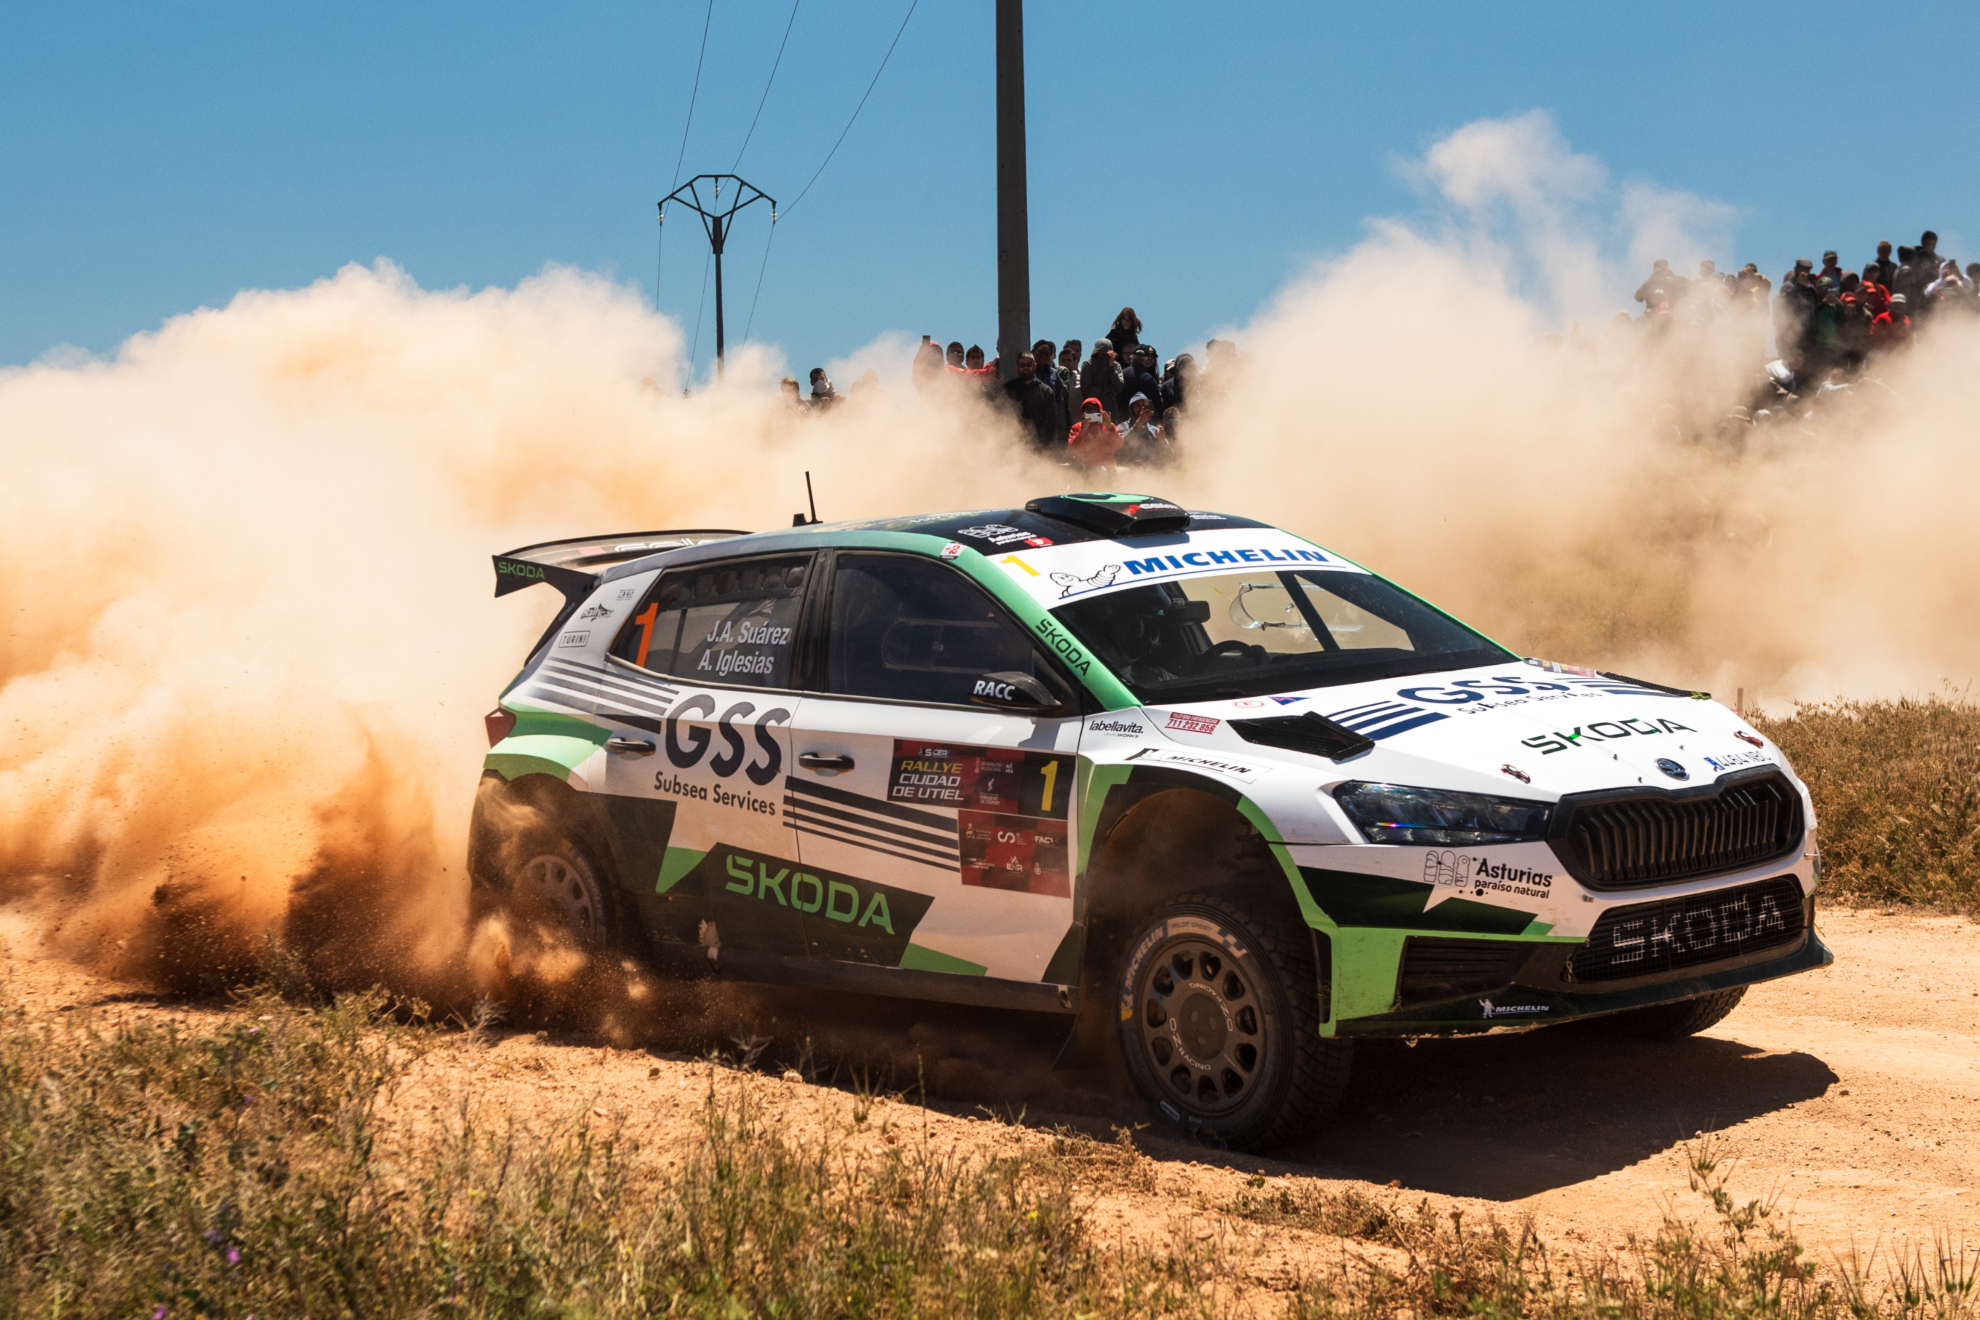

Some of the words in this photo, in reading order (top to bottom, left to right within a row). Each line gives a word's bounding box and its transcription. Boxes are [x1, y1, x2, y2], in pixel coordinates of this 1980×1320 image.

[1000, 554, 1041, 577] 1
[1123, 549, 1330, 575] MICHELIN
[562, 635, 588, 645] TURINI
[635, 602, 659, 668] 1
[707, 620, 734, 642] J.A.
[738, 620, 791, 645] Suárez
[697, 649, 713, 671] A.
[715, 649, 774, 676] Iglesias
[973, 680, 1016, 700] RACC
[1397, 676, 1570, 705] GSS
[1167, 719, 1182, 728] 711
[1183, 721, 1199, 730] 232
[665, 693, 791, 786] GSS
[900, 760, 963, 774] RALLYE
[1166, 755, 1252, 774] MICHELIN
[899, 773, 961, 787] CIUDAD
[1041, 760, 1058, 811] 1
[654, 771, 707, 801] Subsea
[713, 783, 775, 816] Services
[892, 786, 915, 798] DE
[917, 787, 964, 801] UTIEL
[1476, 857, 1553, 887] Asturias
[1474, 880, 1512, 892] paraíso
[1514, 886, 1550, 899] natural
[1125, 926, 1164, 990] MICHELIN
[1495, 1005, 1549, 1013] MICHELIN
[1178, 1047, 1211, 1071] RACING
